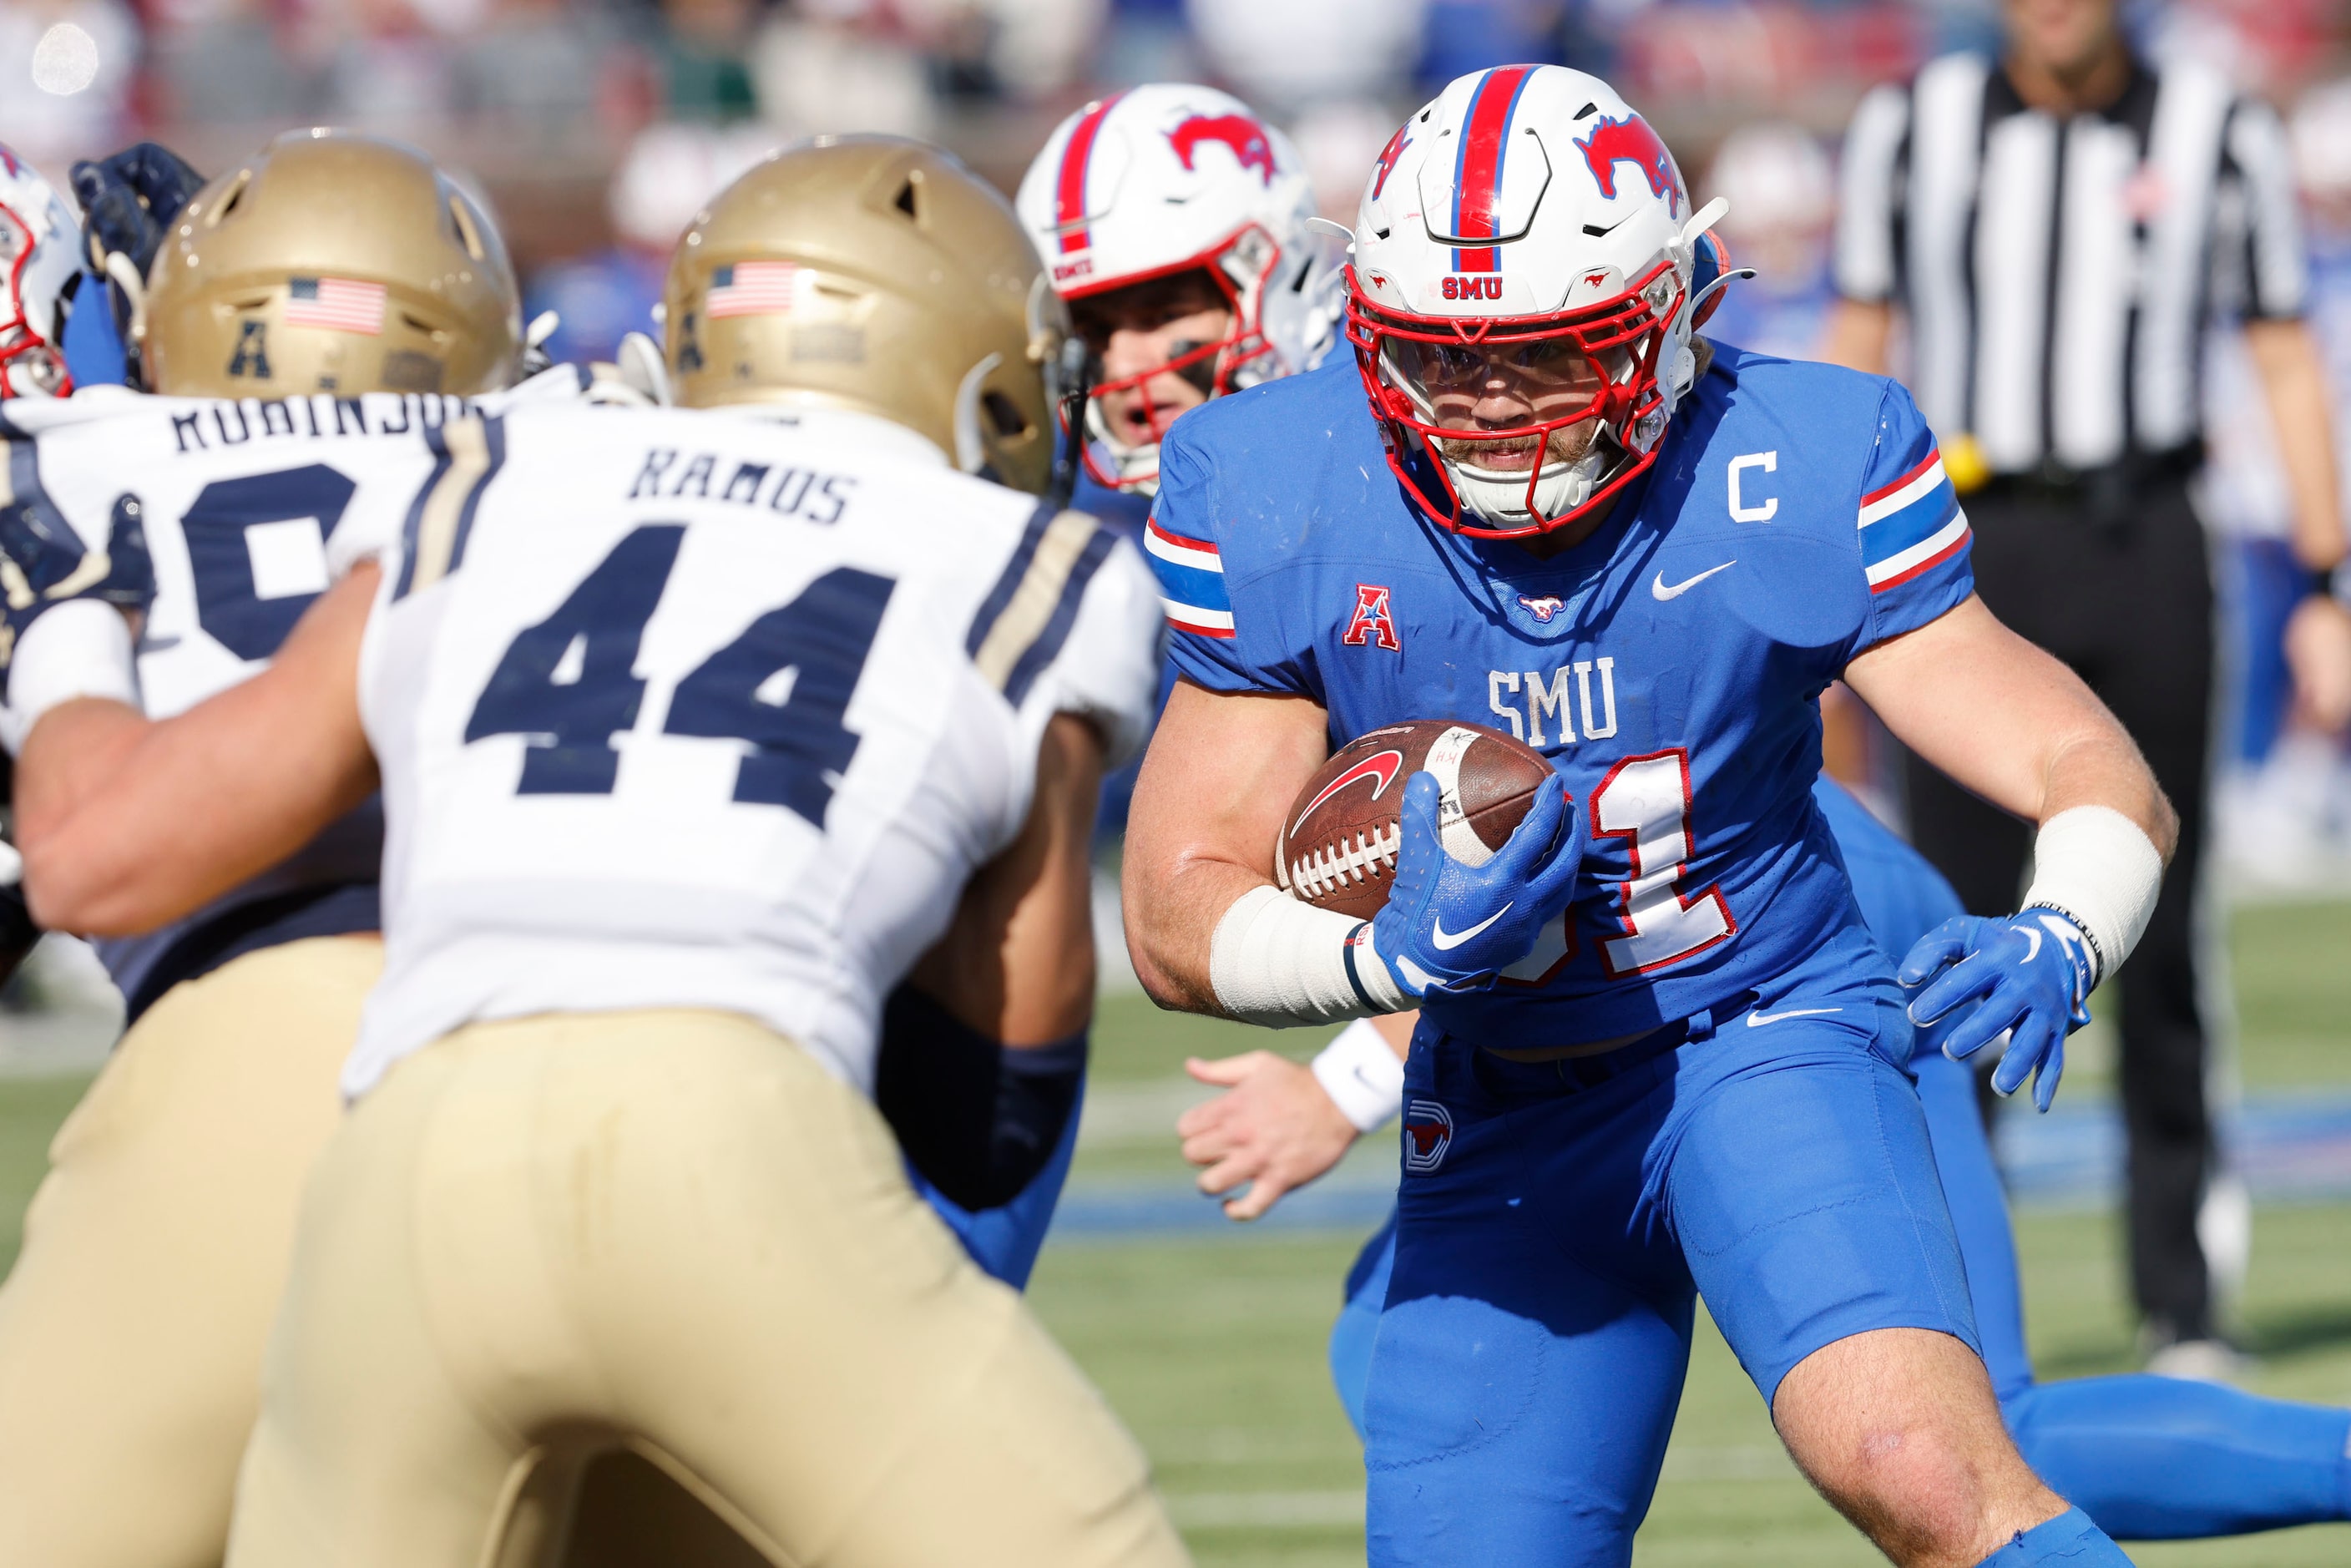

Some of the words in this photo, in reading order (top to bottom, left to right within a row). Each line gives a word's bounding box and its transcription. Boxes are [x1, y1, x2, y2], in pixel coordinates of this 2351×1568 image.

[1441, 276, 1504, 300] SMU
[628, 448, 858, 524] RAMOS
[1727, 450, 1779, 524] C
[463, 524, 897, 835] 44
[1489, 656, 1618, 747] SMU
